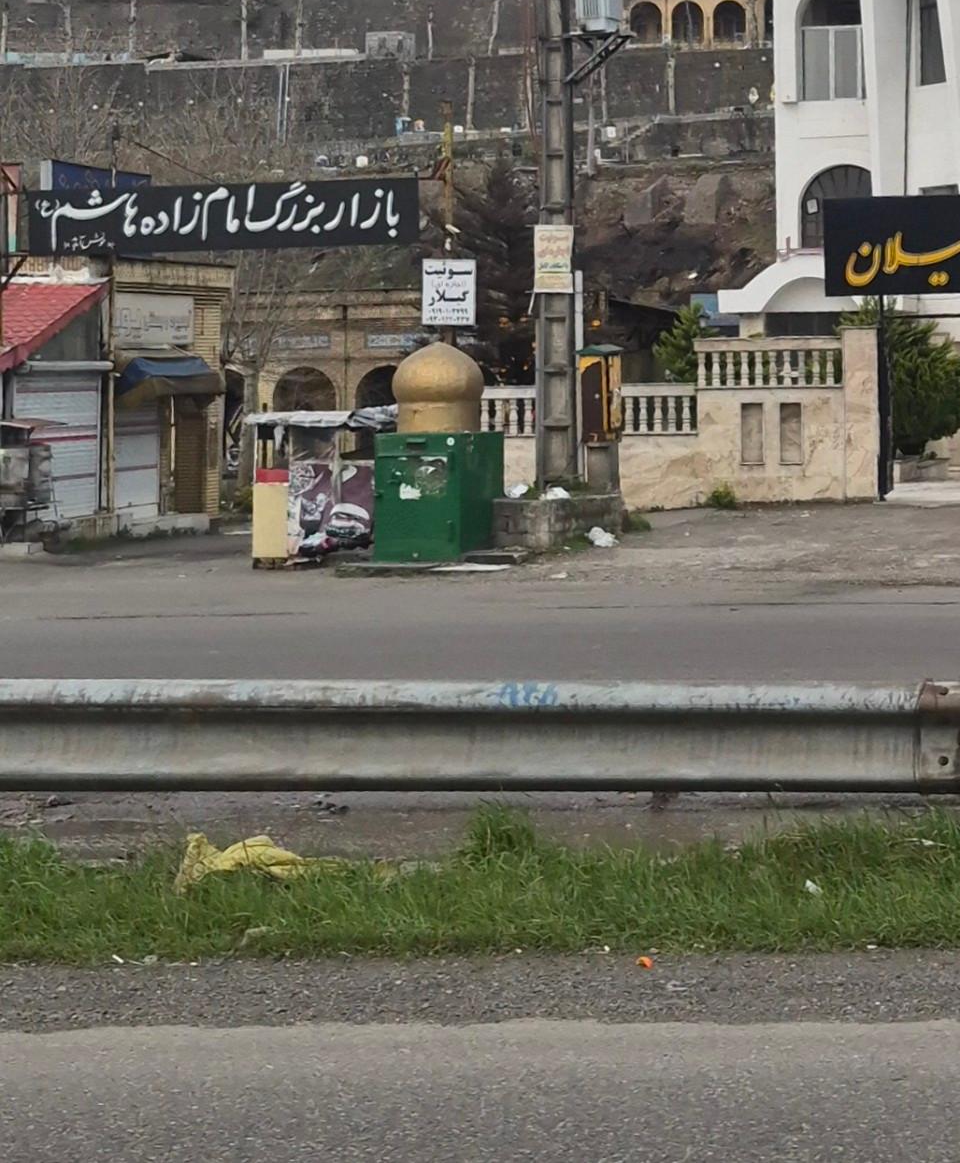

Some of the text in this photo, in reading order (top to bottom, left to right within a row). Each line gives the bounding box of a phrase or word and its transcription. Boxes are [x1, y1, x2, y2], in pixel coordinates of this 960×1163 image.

[51, 189, 138, 252] هاشم
[244, 181, 326, 235] بزرگ
[323, 188, 400, 238] بازار
[425, 262, 473, 279] سوئیت
